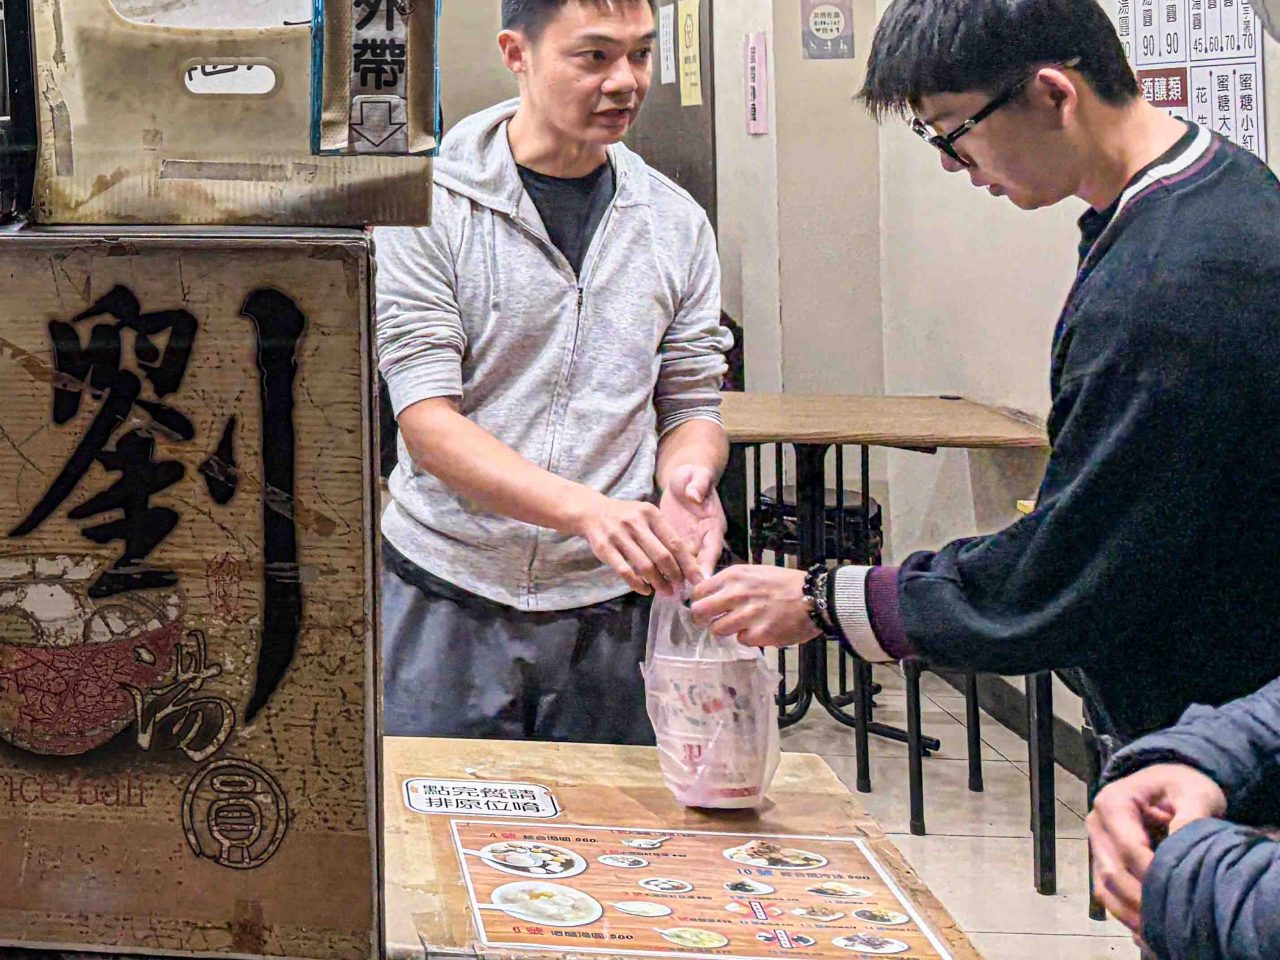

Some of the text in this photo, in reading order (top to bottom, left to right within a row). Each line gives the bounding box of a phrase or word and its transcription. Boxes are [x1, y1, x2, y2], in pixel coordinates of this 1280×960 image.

[1143, 35, 1154, 56] 90
[1166, 32, 1179, 54] 90
[1193, 38, 1202, 53] 45
[1209, 36, 1218, 52] 60
[1225, 35, 1235, 50] 70
[1242, 33, 1253, 49] 70
